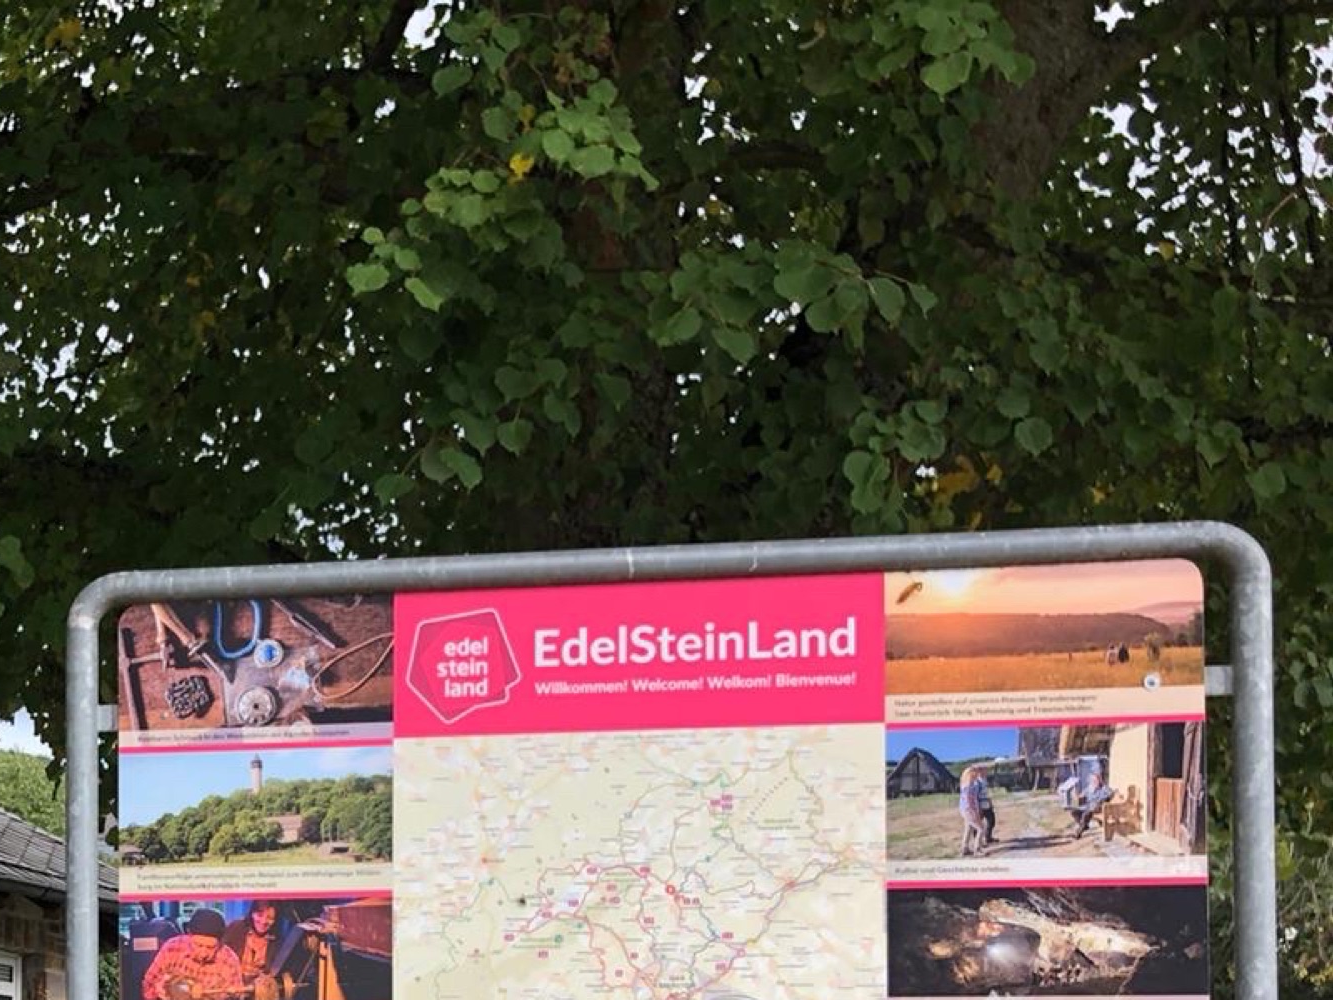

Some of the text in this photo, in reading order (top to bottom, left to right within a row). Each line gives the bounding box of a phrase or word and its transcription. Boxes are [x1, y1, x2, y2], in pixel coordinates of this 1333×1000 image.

[443, 637, 488, 658] edel
[533, 614, 857, 668] EdelSteinLand
[436, 659, 488, 678] stein
[443, 678, 488, 698] land
[534, 671, 857, 695] Willkommen! Welcome! Welkom! Bienvenue!
